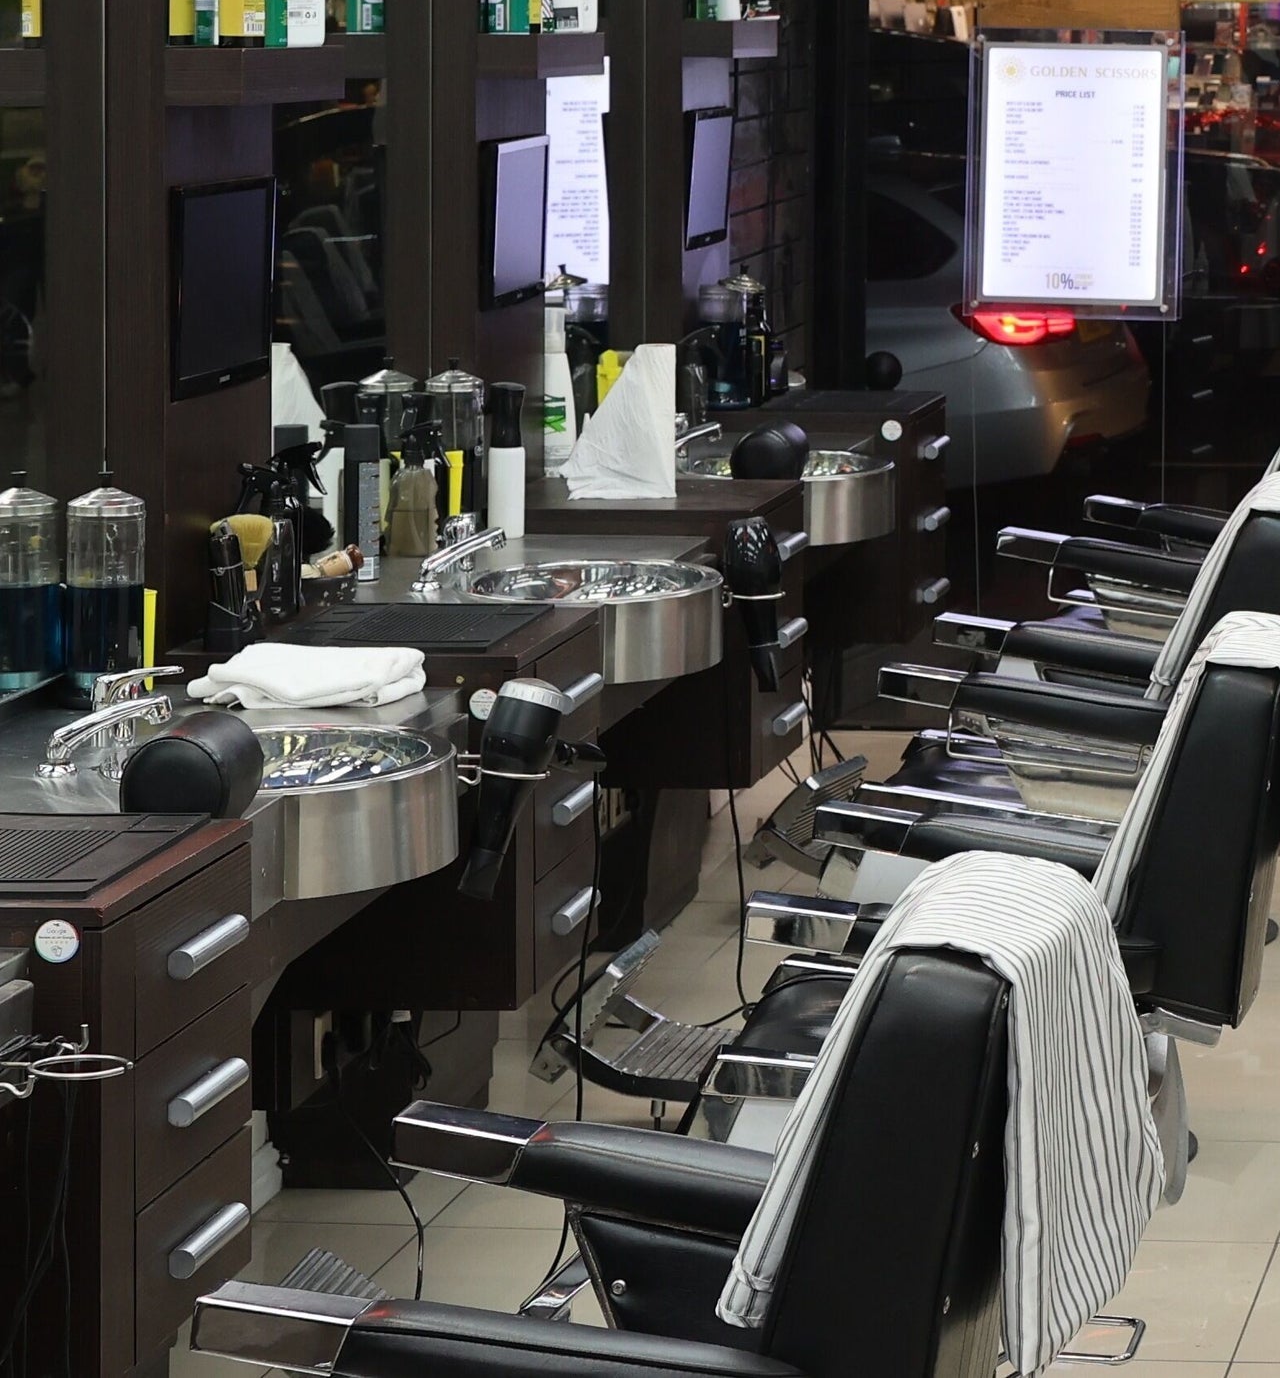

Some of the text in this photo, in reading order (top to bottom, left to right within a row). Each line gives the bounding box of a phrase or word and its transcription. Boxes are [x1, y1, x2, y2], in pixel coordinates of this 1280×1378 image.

[1030, 65, 1157, 79] GOLDEN SCISSORS
[1055, 90, 1096, 99] PRICE LIST
[1045, 272, 1074, 290] 10%
